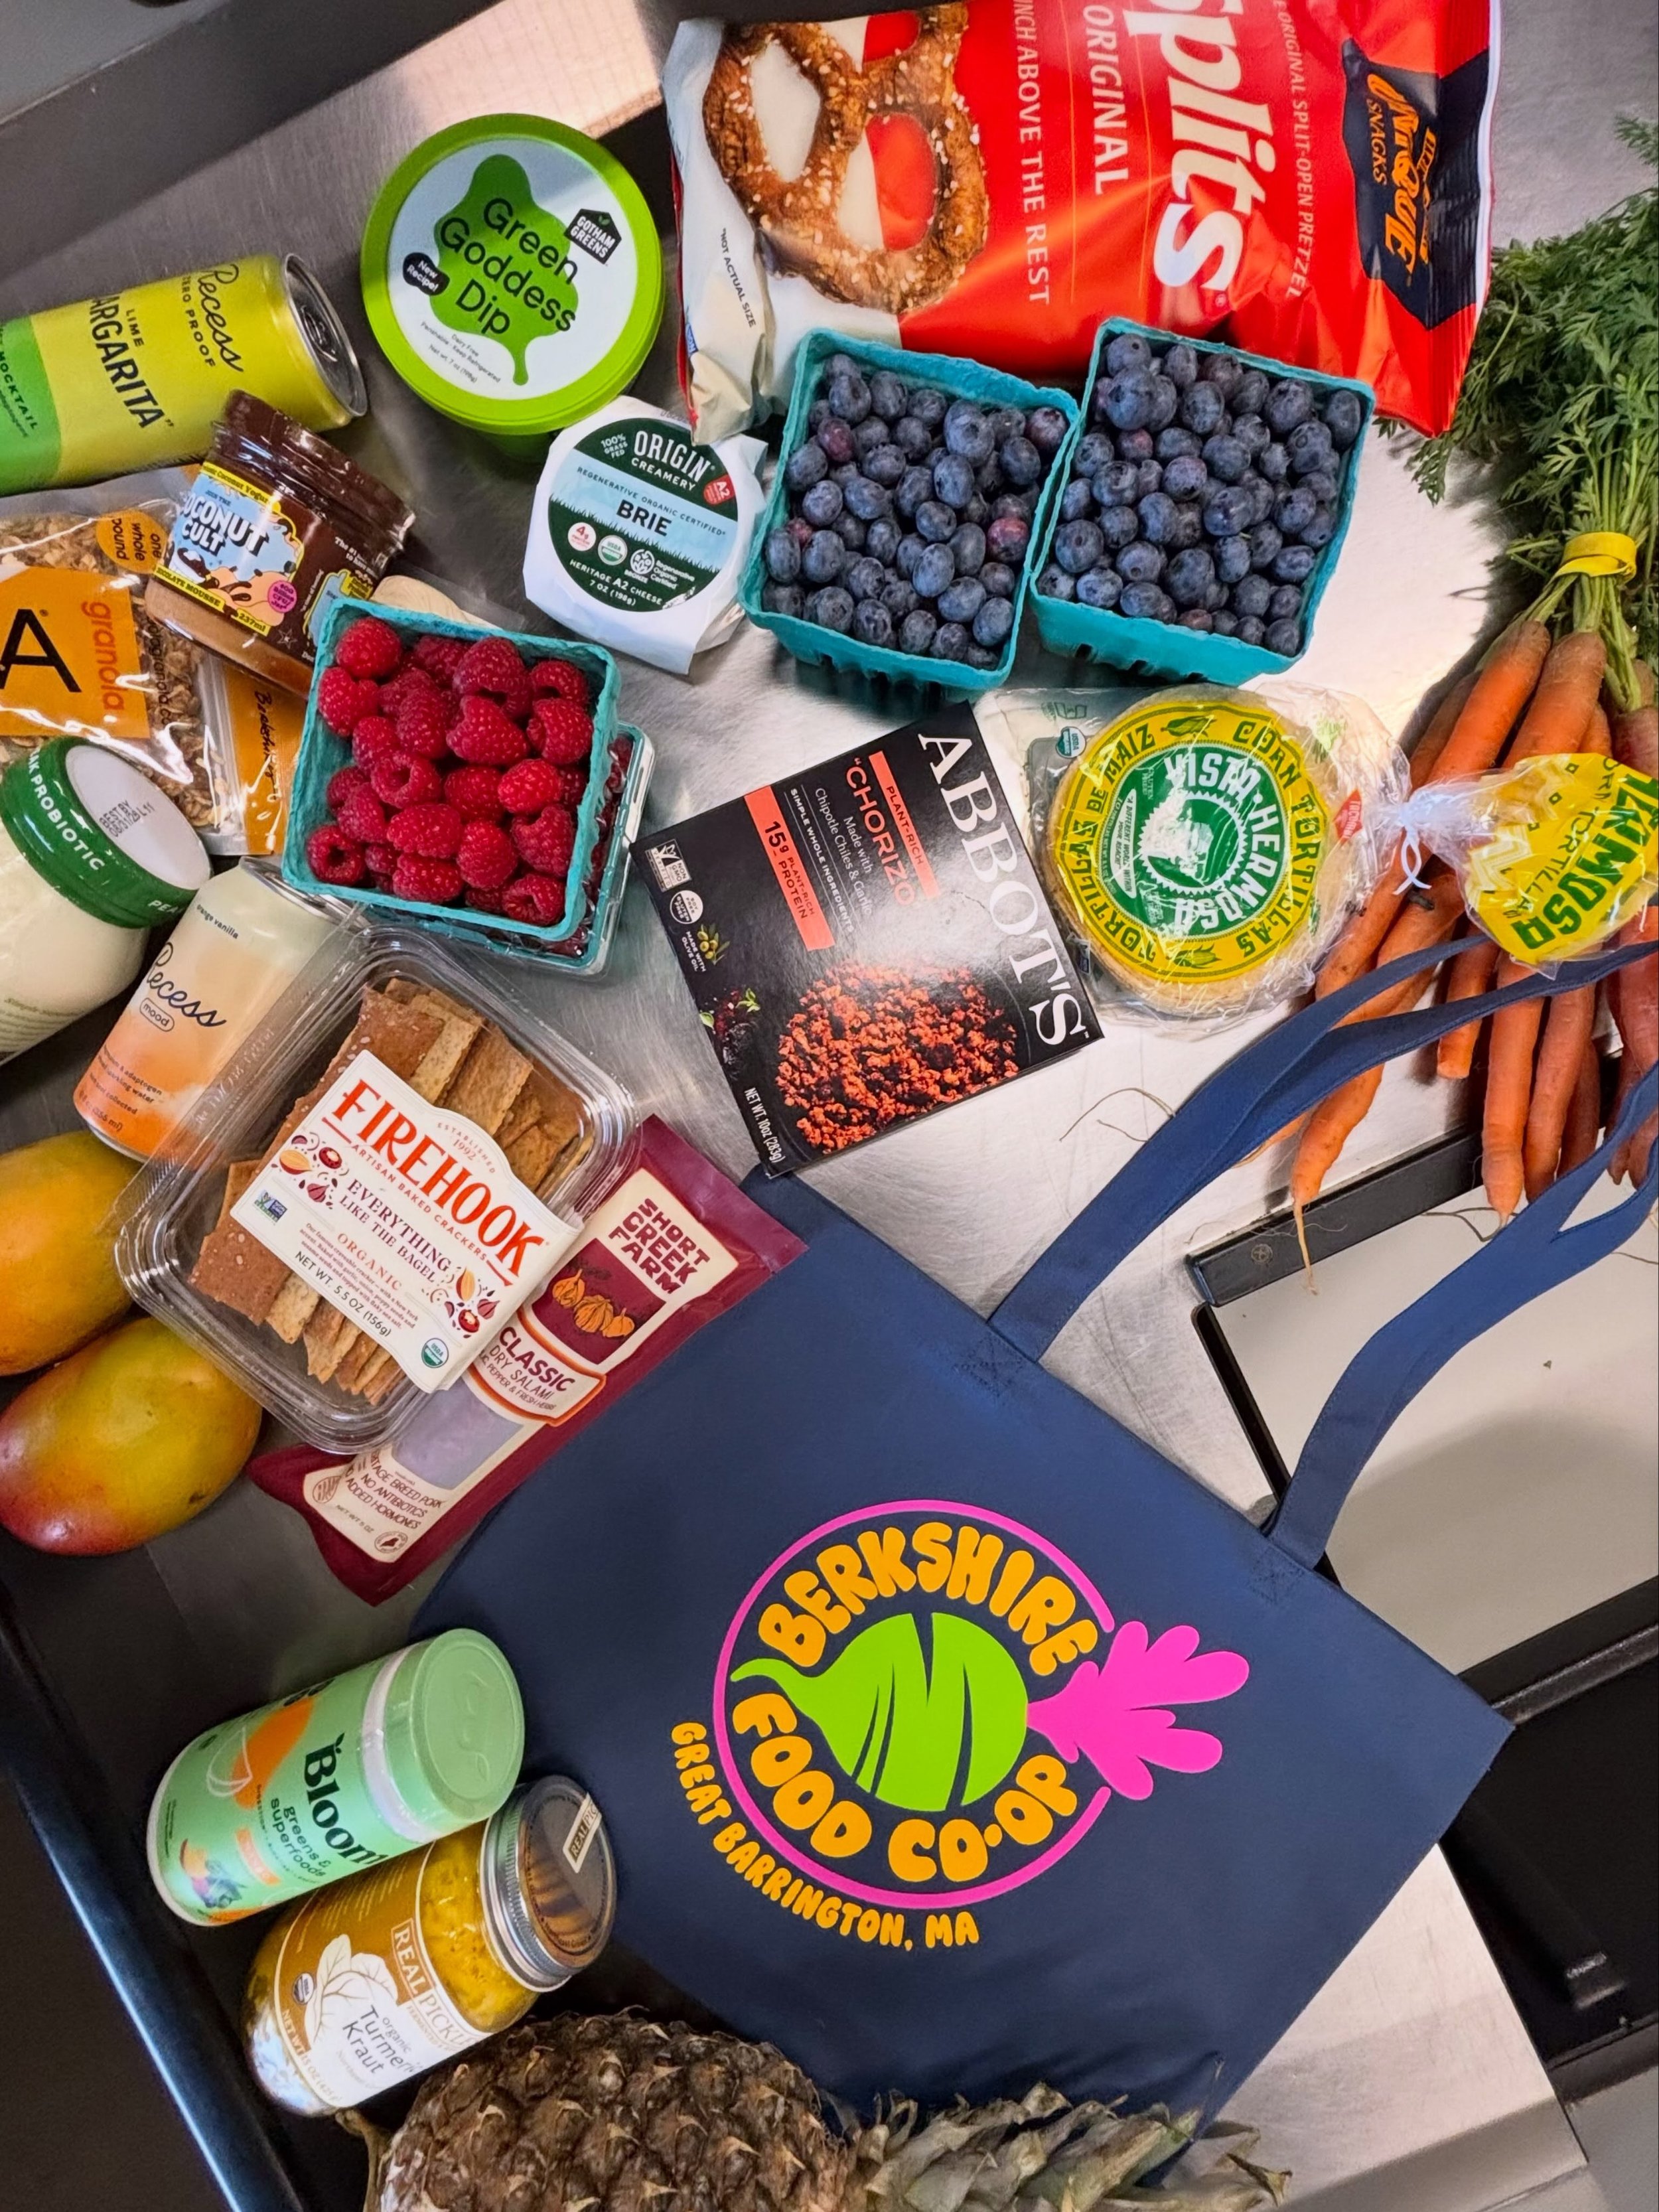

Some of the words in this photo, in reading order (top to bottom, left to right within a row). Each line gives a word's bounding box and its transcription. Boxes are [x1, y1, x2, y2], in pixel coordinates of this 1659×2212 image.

[1277, 12, 1306, 94] ORIGINAL
[1017, 46, 1043, 144] ABOVE
[1083, 5, 1128, 195] ORIGINAL
[1123, 0, 1275, 291] plits
[1291, 99, 1313, 207] SPLIT-OPEN
[1366, 99, 1387, 186] SNACKS
[1020, 152, 1046, 214] THE
[483, 198, 579, 285] Green
[569, 225, 610, 259] GREENS
[575, 215, 616, 248] GOTHAM
[1285, 211, 1315, 298] PRETZEL
[407, 265, 439, 292] Recipe!
[418, 261, 438, 279] New
[440, 217, 577, 332] Goddess
[1025, 227, 1050, 305] REST
[198, 263, 244, 372] Recess
[455, 279, 510, 334] Dip
[724, 257, 746, 302] ACTUAL
[742, 302, 757, 328] SIZE
[125, 309, 145, 347] LIME
[186, 309, 216, 368] PROOF
[466, 344, 480, 357] Free
[600, 433, 627, 449] 100%
[604, 441, 628, 456] GRASS
[611, 448, 626, 460] FED
[634, 430, 711, 482] ORIGIN
[577, 467, 638, 500] REGENERATIVE
[641, 495, 679, 517] ORGANIC
[631, 457, 697, 492] CREAMERY
[716, 481, 731, 499] A2
[112, 518, 129, 561] pound
[132, 522, 145, 562] whole
[181, 519, 227, 557] CULT
[616, 499, 672, 537] BRIE
[149, 533, 161, 559] one
[186, 583, 221, 608] MOUSSE
[569, 559, 612, 583] HERITAGE
[613, 578, 630, 591] A2
[630, 586, 663, 605] CHEESE
[597, 583, 609, 594] OZ
[610, 589, 636, 607] (198g)
[238, 611, 267, 632] 237ml
[81, 601, 126, 711] granola
[1106, 724, 1157, 785] MAIZ
[1164, 753, 1262, 796] VISTA
[1233, 721, 1301, 790] CORN
[31, 774, 106, 872] PROBIOTIC
[99, 810, 120, 830] BEST
[117, 799, 131, 816] BY
[814, 788, 839, 836] Chipotle
[886, 785, 924, 865] PLANT-RICH
[1086, 789, 1109, 815] DE
[676, 861, 687, 880] NON
[764, 820, 790, 857] 15g
[787, 856, 816, 915] PLANT-RICH
[790, 788, 810, 826] SIMPLE
[806, 826, 826, 864] WHOLE
[822, 864, 855, 932] INGREDIENTS
[834, 835, 853, 870] Chiles
[843, 816, 862, 848] Made
[857, 846, 873, 875] with
[1175, 805, 1281, 929] HERMOSA
[671, 864, 683, 883] GMO
[778, 860, 808, 919] PROTEIN
[848, 869, 859, 881] &
[853, 880, 873, 916] Garlic
[917, 733, 1086, 1047] ABBOT'S
[1070, 818, 1159, 964] TORTILLAS
[1236, 793, 1322, 957] TORTILLAS
[214, 918, 239, 940] vanilla
[676, 895, 690, 922] GLUTEN
[681, 936, 693, 958] OLIVE
[690, 958, 699, 972] OIL
[686, 930, 698, 952] MADE
[694, 952, 707, 973] WITH
[146, 940, 228, 1027] Recess
[143, 1003, 170, 1027] mood
[124, 1068, 163, 1096] adaptogen
[132, 1087, 155, 1104] water
[744, 1086, 761, 1104] NET
[751, 1102, 767, 1121] WT.
[757, 1118, 773, 1138] 10oz
[437, 1122, 496, 1175] ESTABLISHED
[451, 1137, 478, 1161] 1992
[762, 1136, 786, 1163] (283g)
[332, 1078, 545, 1278] FIREHOOK
[350, 1143, 397, 1185] ARTISAN
[398, 1183, 432, 1213] BAKED
[433, 1213, 488, 1263] CRACKERS
[338, 1195, 370, 1224] LIKE
[370, 1222, 397, 1249] THE
[396, 1245, 438, 1284] BAGEL
[347, 1179, 453, 1274] EVERYTHING
[622, 1211, 699, 1284] CREEK
[638, 1197, 711, 1266] SHORT
[337, 1232, 403, 1291] ORGANIC
[609, 1226, 683, 1295] FARM
[295, 1250, 317, 1271] NET
[315, 1266, 334, 1288] WT.
[334, 1285, 350, 1301] 5.5
[348, 1297, 365, 1313] OZ
[362, 1309, 393, 1338] (156g)
[431, 1343, 445, 1358] USDA
[489, 1344, 513, 1370] DRY
[510, 1368, 555, 1401] SALAMI
[499, 1326, 577, 1393] CLASSIC
[486, 1364, 510, 1388] PEPPER
[508, 1386, 516, 1394] &
[515, 1389, 538, 1405] FRESH
[335, 1504, 349, 1517] NET
[348, 1514, 360, 1524] WT
[364, 1525, 376, 1534] OZ
[345, 1477, 374, 1505] ADDED
[370, 1500, 422, 1530] HORMONES
[360, 1472, 376, 1489] NO
[374, 1487, 429, 1518] ANTIBIOTICS
[390, 1478, 421, 1501] BREED
[419, 1496, 443, 1509] PORK
[757, 1520, 1099, 1676] BERKSHIRE
[731, 1692, 873, 1858] FOOD
[269, 1796, 328, 1879] superfoods
[283, 1805, 321, 1861] greens
[570, 1824, 589, 1861] REAL
[672, 1721, 733, 1825] GREAT
[713, 1822, 914, 1952] BARRINGTON,
[924, 1910, 980, 1949] MA
[394, 1928, 421, 2002] REAL
[342, 2020, 385, 2075] Kraut
[382, 2016, 413, 2053] organic
